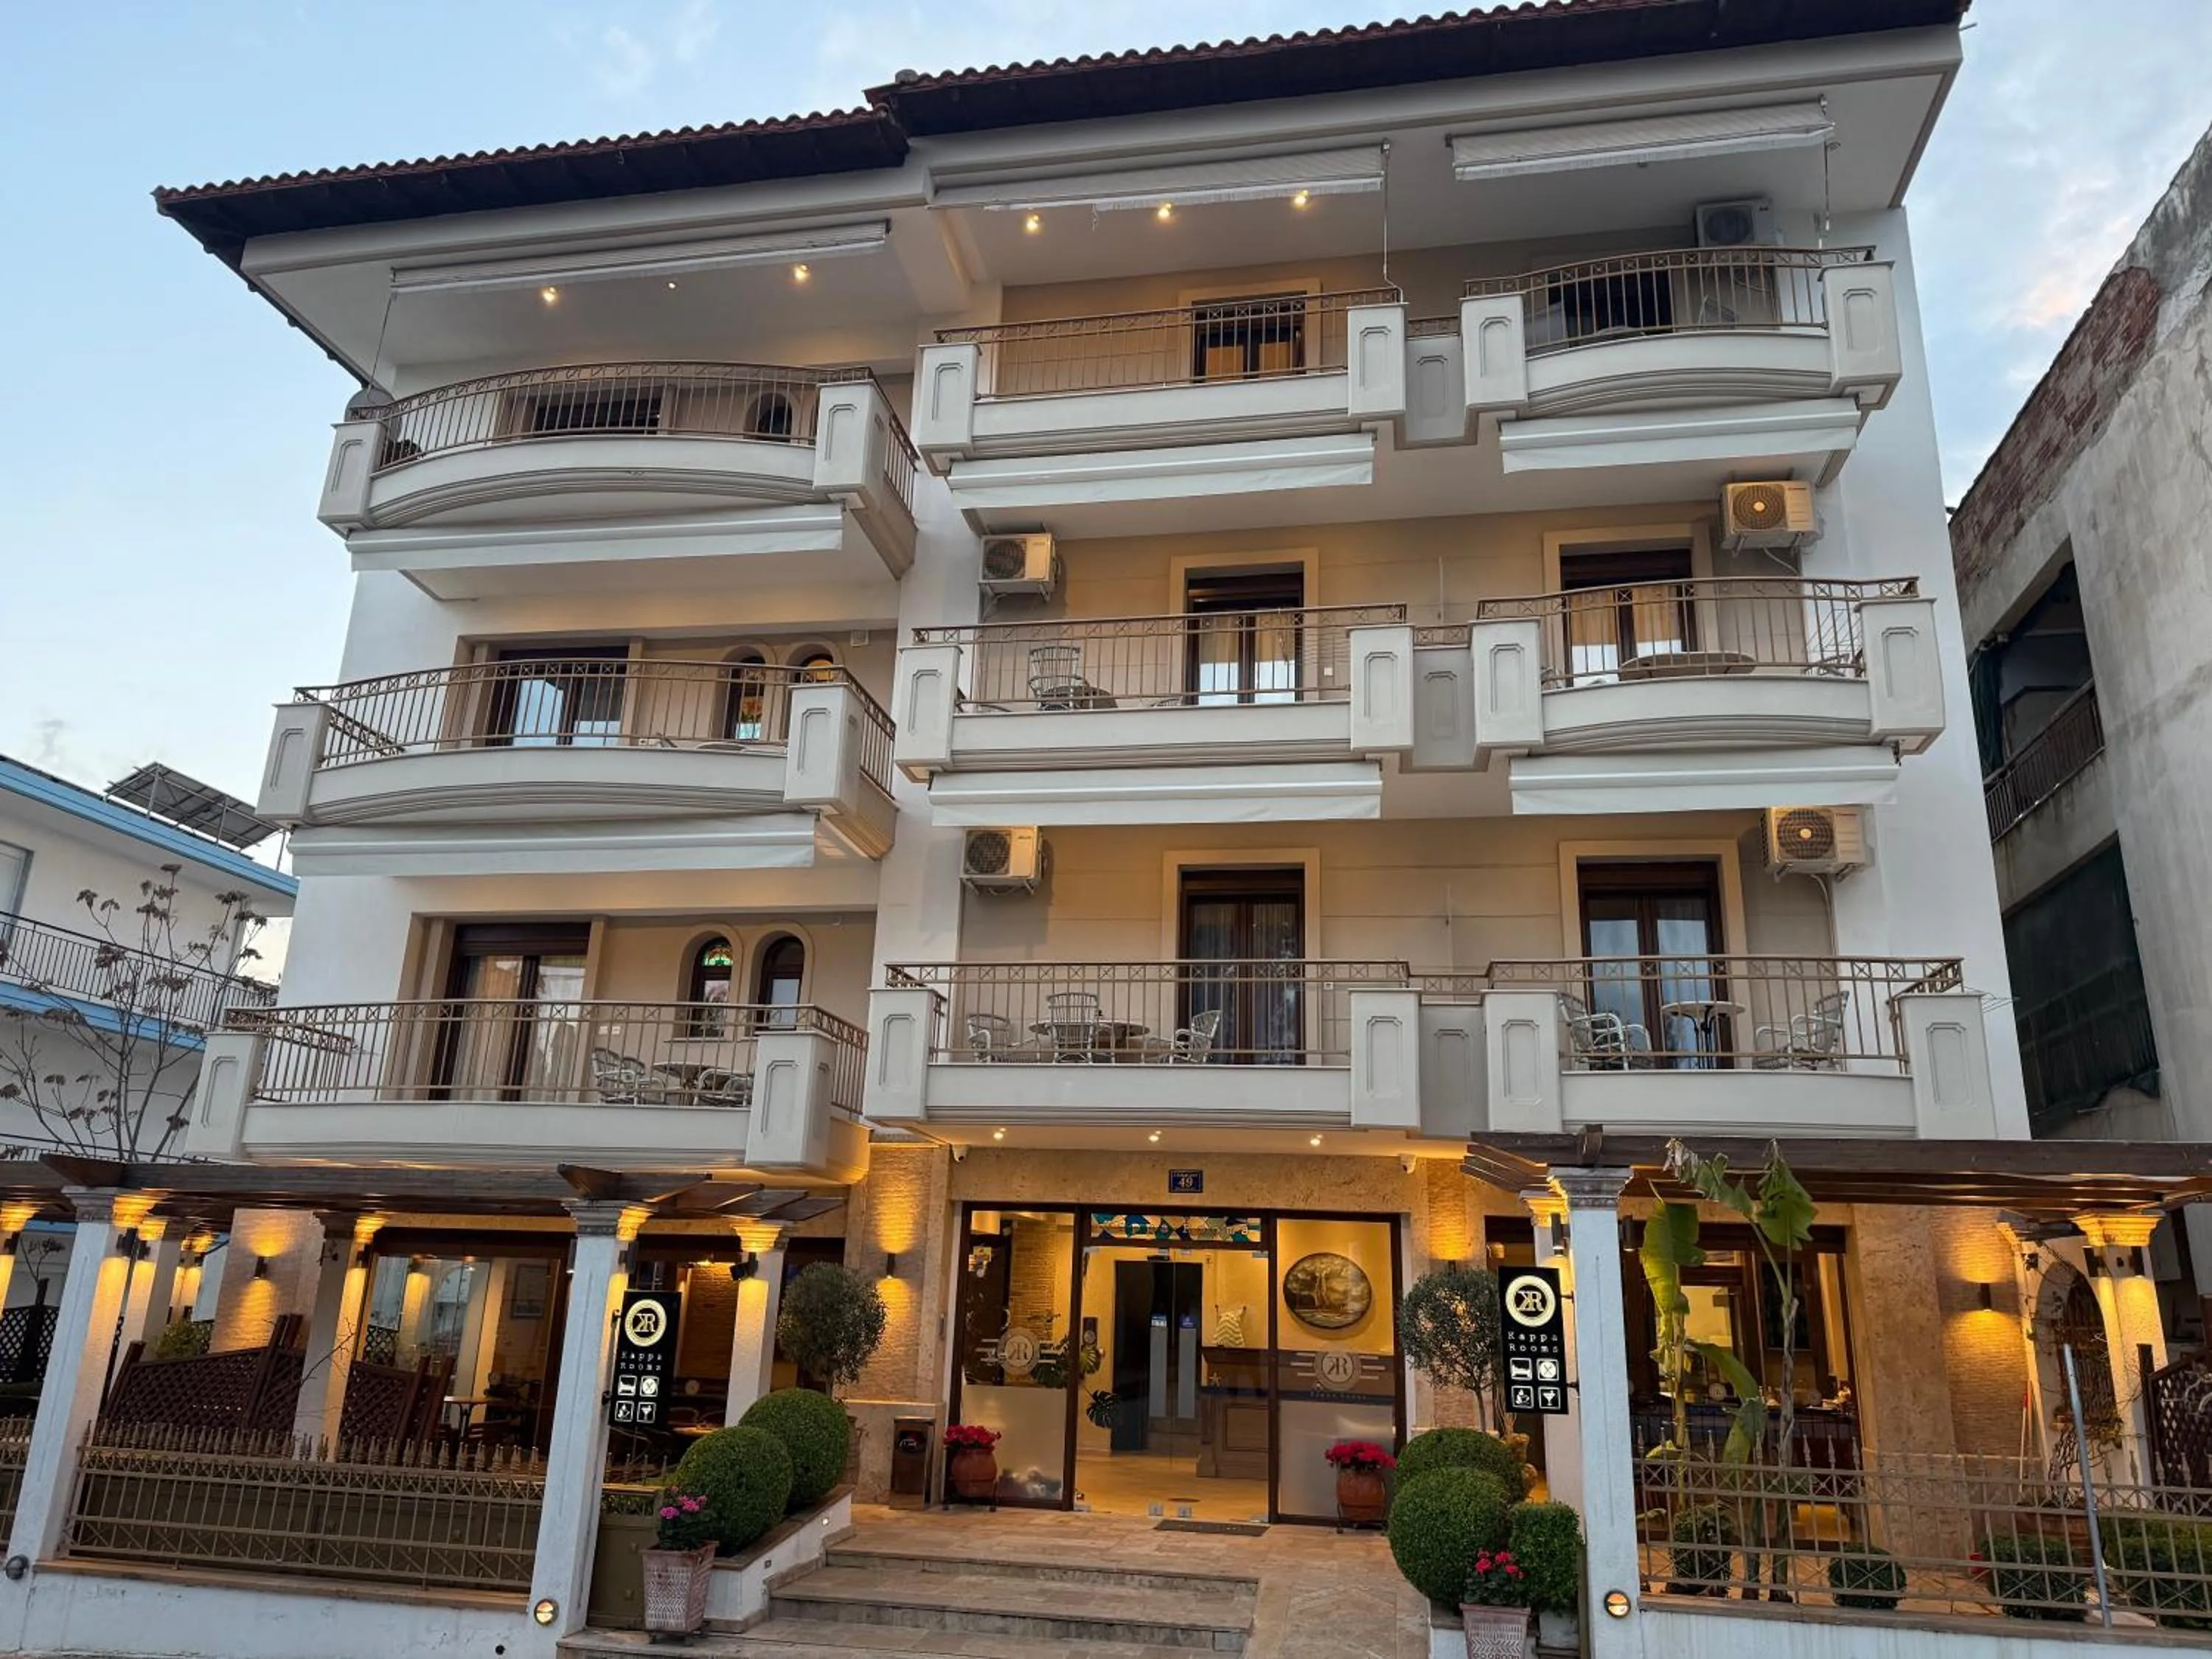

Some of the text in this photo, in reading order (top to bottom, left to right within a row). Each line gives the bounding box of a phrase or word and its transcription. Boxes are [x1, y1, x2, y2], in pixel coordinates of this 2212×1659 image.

[1179, 1178, 1193, 1188] 49
[1507, 1330, 1558, 1343] Kappa
[1509, 1343, 1559, 1353] Rooms
[621, 1351, 662, 1362] Kappa
[620, 1362, 661, 1371] Rooms
